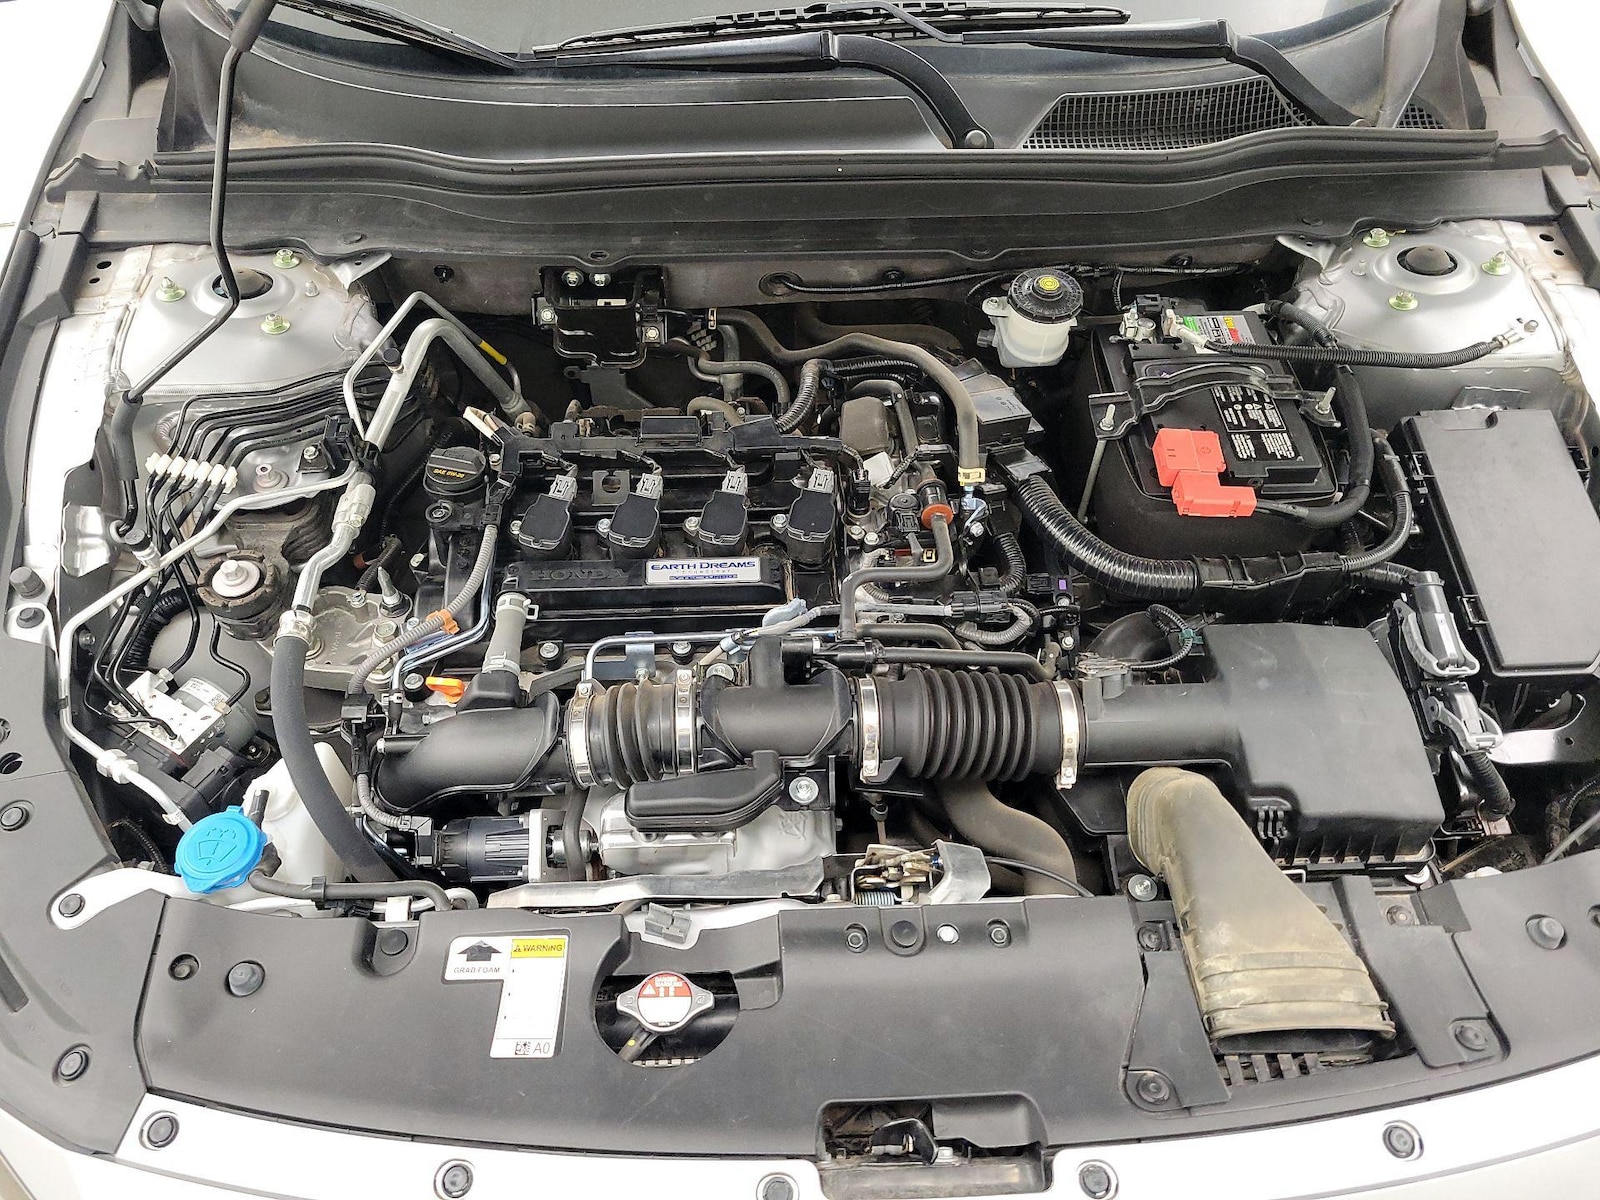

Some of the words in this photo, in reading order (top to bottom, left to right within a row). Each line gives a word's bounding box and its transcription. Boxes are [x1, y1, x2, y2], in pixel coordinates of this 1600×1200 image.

[432, 468, 447, 476] SAE
[651, 563, 697, 571] EARTH
[700, 561, 756, 569] DREAMS
[530, 568, 629, 581] HONDA
[523, 944, 563, 952] WARNING
